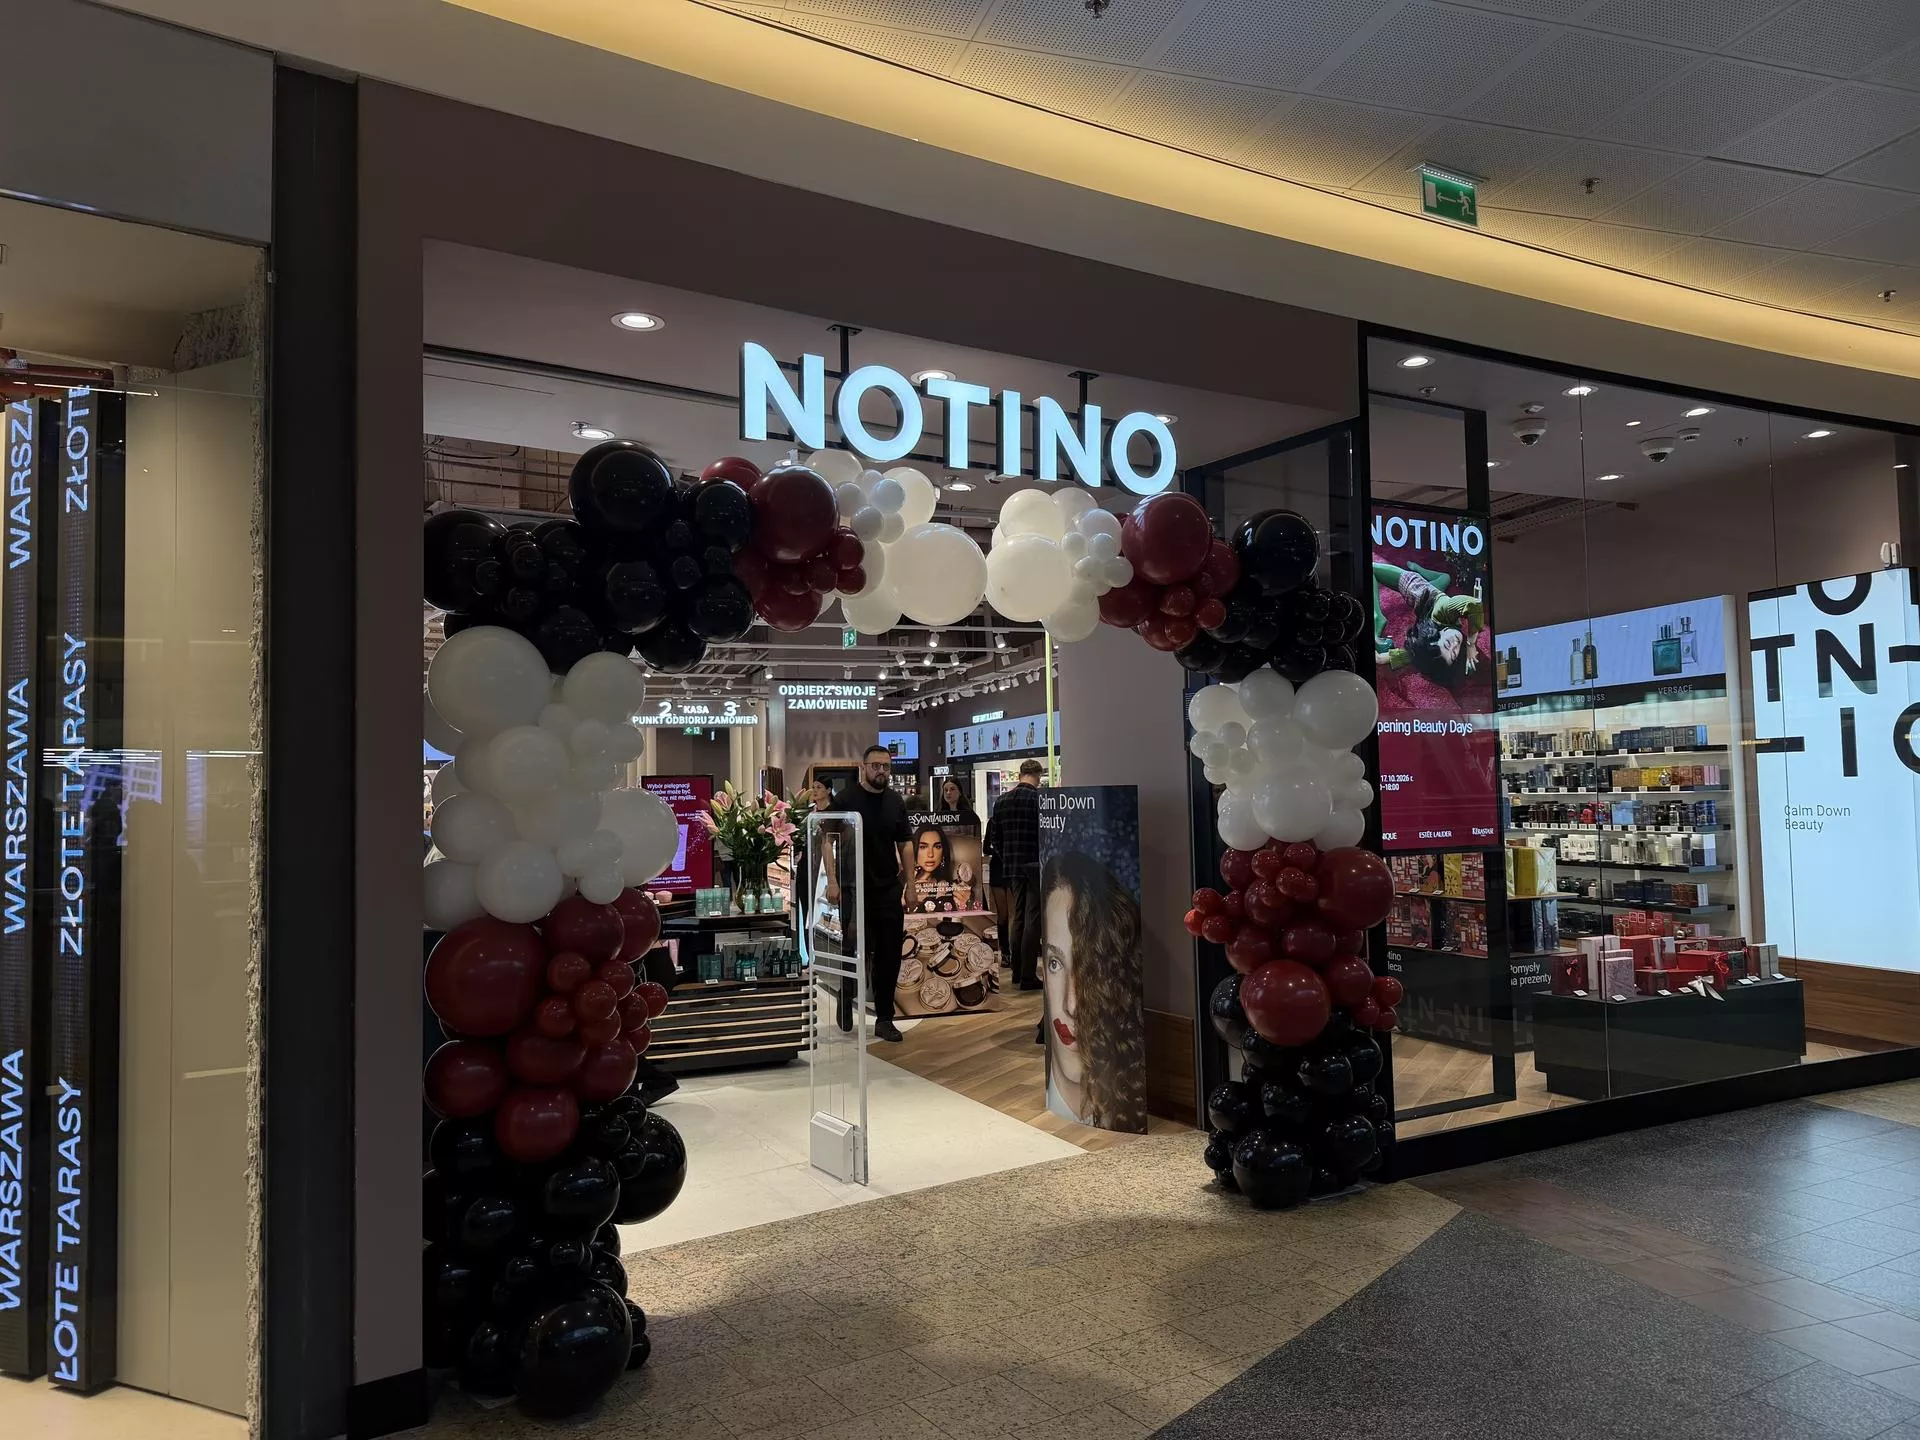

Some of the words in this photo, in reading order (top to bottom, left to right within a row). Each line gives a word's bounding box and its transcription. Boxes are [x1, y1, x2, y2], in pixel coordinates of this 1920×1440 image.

[741, 341, 1177, 496] NOTINO
[1371, 515, 1484, 556] NOTINO
[779, 685, 832, 696] ODBIERZ
[834, 685, 877, 696] SWOJE
[1658, 684, 1693, 695] VERSACE
[659, 701, 673, 719] 2
[683, 705, 710, 714] KASA
[724, 701, 737, 717] 3
[788, 697, 868, 710] ZAMÓWIENIE
[62, 631, 87, 803] TARASY
[632, 715, 665, 725] PUNKT
[665, 715, 707, 725] ODBIORU
[1413, 719, 1447, 737] Beauty
[1449, 719, 1473, 737] Days
[4, 678, 29, 935] WARSZAWA
[1039, 794, 1056, 810] Calm
[1059, 794, 1096, 810] Down
[1784, 805, 1813, 817] Calm
[1817, 805, 1851, 817] Down
[1039, 813, 1066, 833] Beauty
[1785, 819, 1824, 833] Beauty
[60, 811, 85, 957] ZŁOTE
[1519, 974, 1551, 988] prezenty
[57, 1076, 82, 1246] TARASY
[0, 1049, 24, 1311] WARSZAWA
